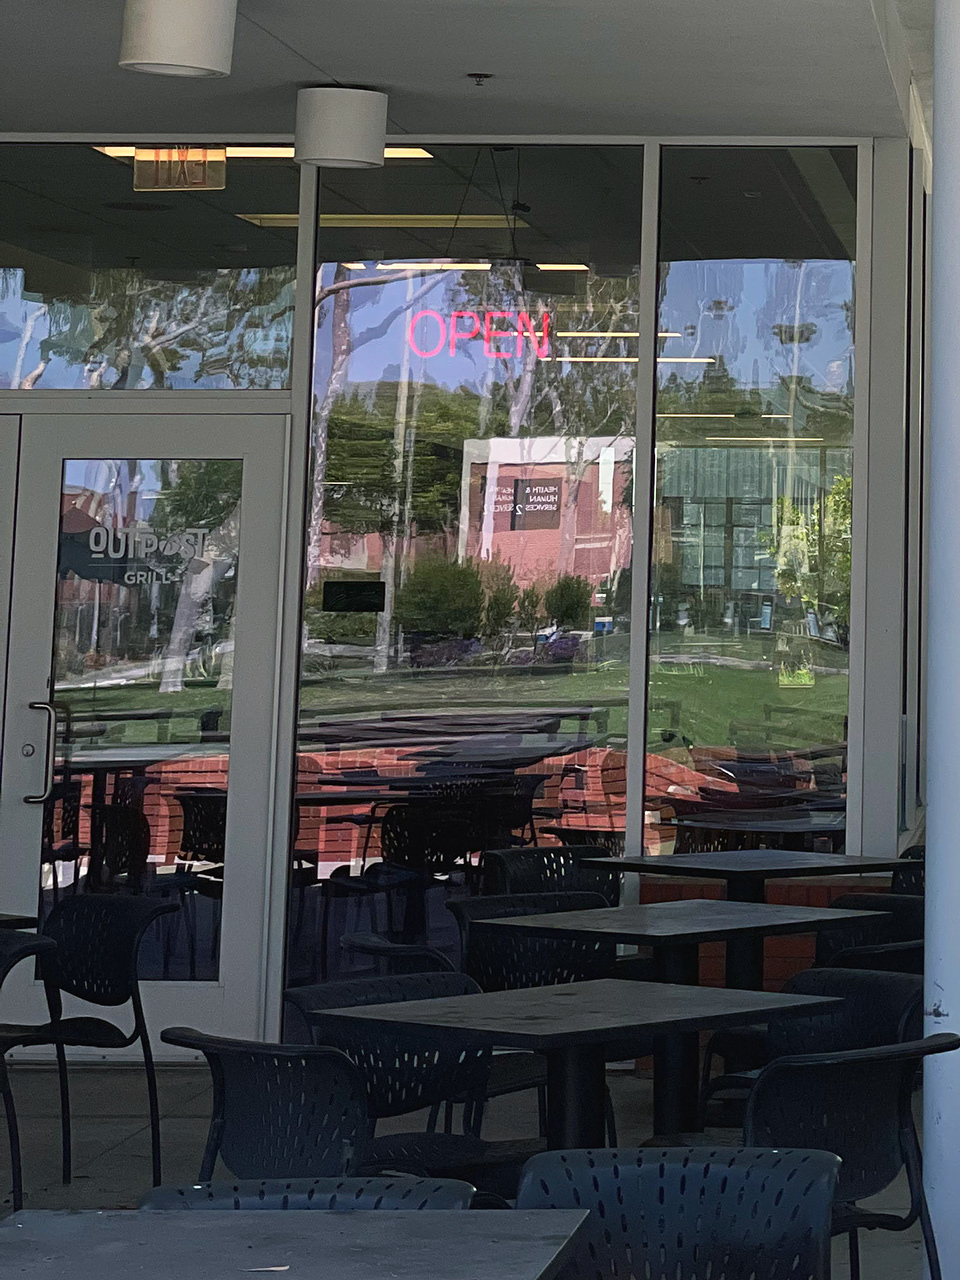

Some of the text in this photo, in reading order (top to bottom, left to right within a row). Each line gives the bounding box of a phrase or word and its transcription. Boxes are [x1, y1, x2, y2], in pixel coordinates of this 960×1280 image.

[408, 309, 550, 358] OPEN
[89, 526, 210, 560] OUTPOST
[124, 571, 171, 584] GRILL
